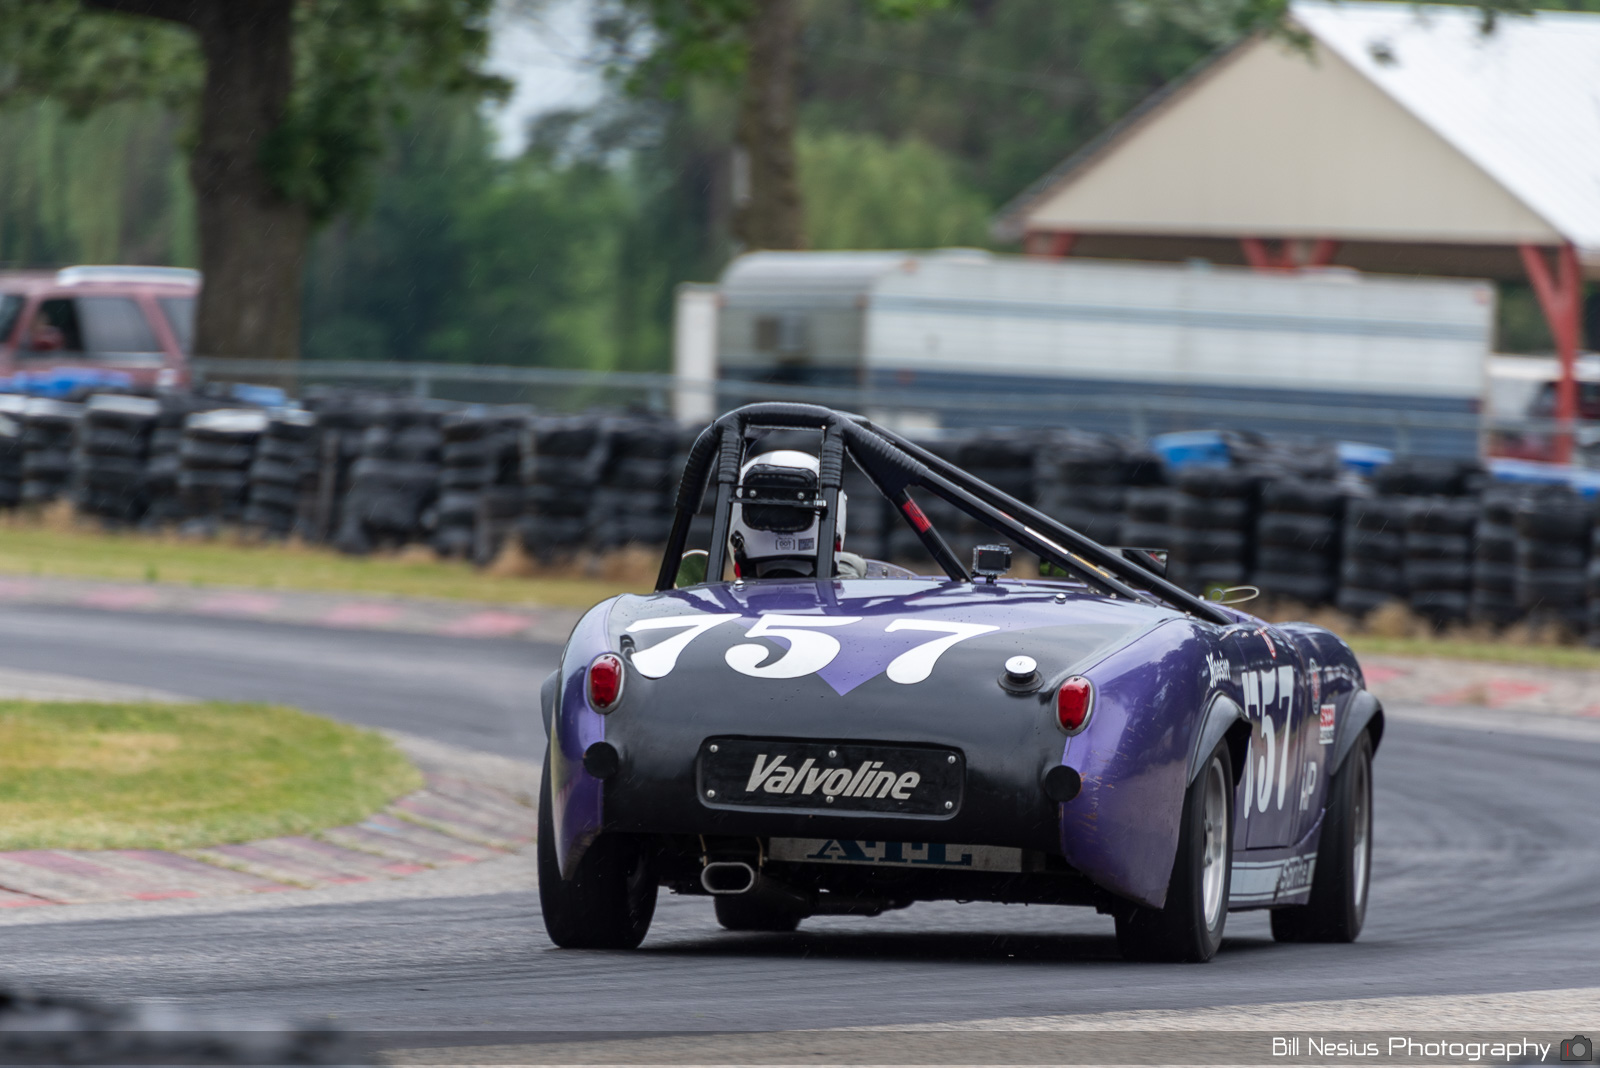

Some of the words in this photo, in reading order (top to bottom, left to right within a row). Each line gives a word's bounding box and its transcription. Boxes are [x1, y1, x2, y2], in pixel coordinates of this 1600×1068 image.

[625, 613, 1001, 685] 757
[745, 754, 921, 800] Valvoline
[1241, 665, 1294, 820] 757
